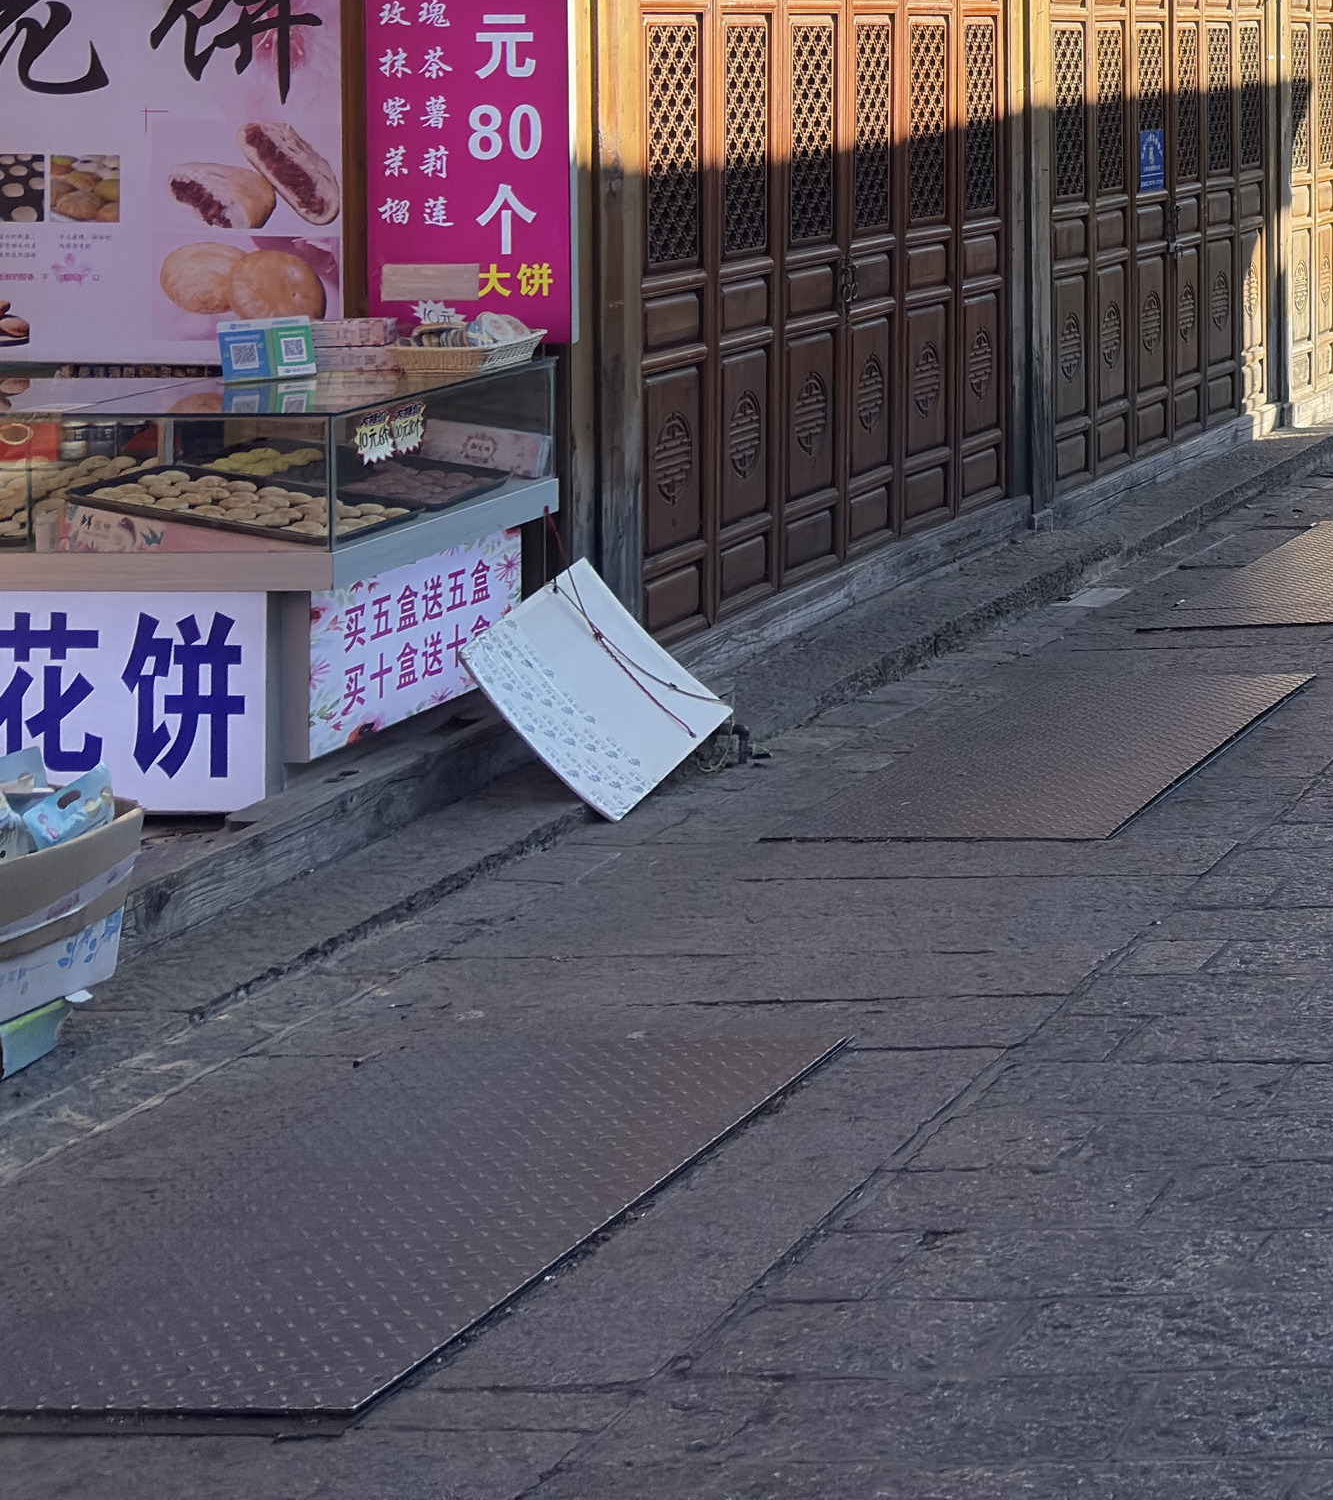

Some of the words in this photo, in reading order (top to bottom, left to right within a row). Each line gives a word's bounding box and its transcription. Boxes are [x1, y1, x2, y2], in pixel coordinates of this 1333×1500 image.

[379, 0, 452, 29] 玫瑰
[379, 47, 454, 80] 抹茶
[475, 13, 536, 80] 元
[382, 96, 452, 129] 紫薯
[467, 103, 544, 162] 80
[382, 146, 451, 180] 茉莉
[378, 195, 456, 229] 榴莲
[475, 184, 537, 256] 个
[477, 263, 555, 299] 大饼
[343, 559, 491, 654] 买五盒送五盒
[0, 610, 246, 779] 花饼
